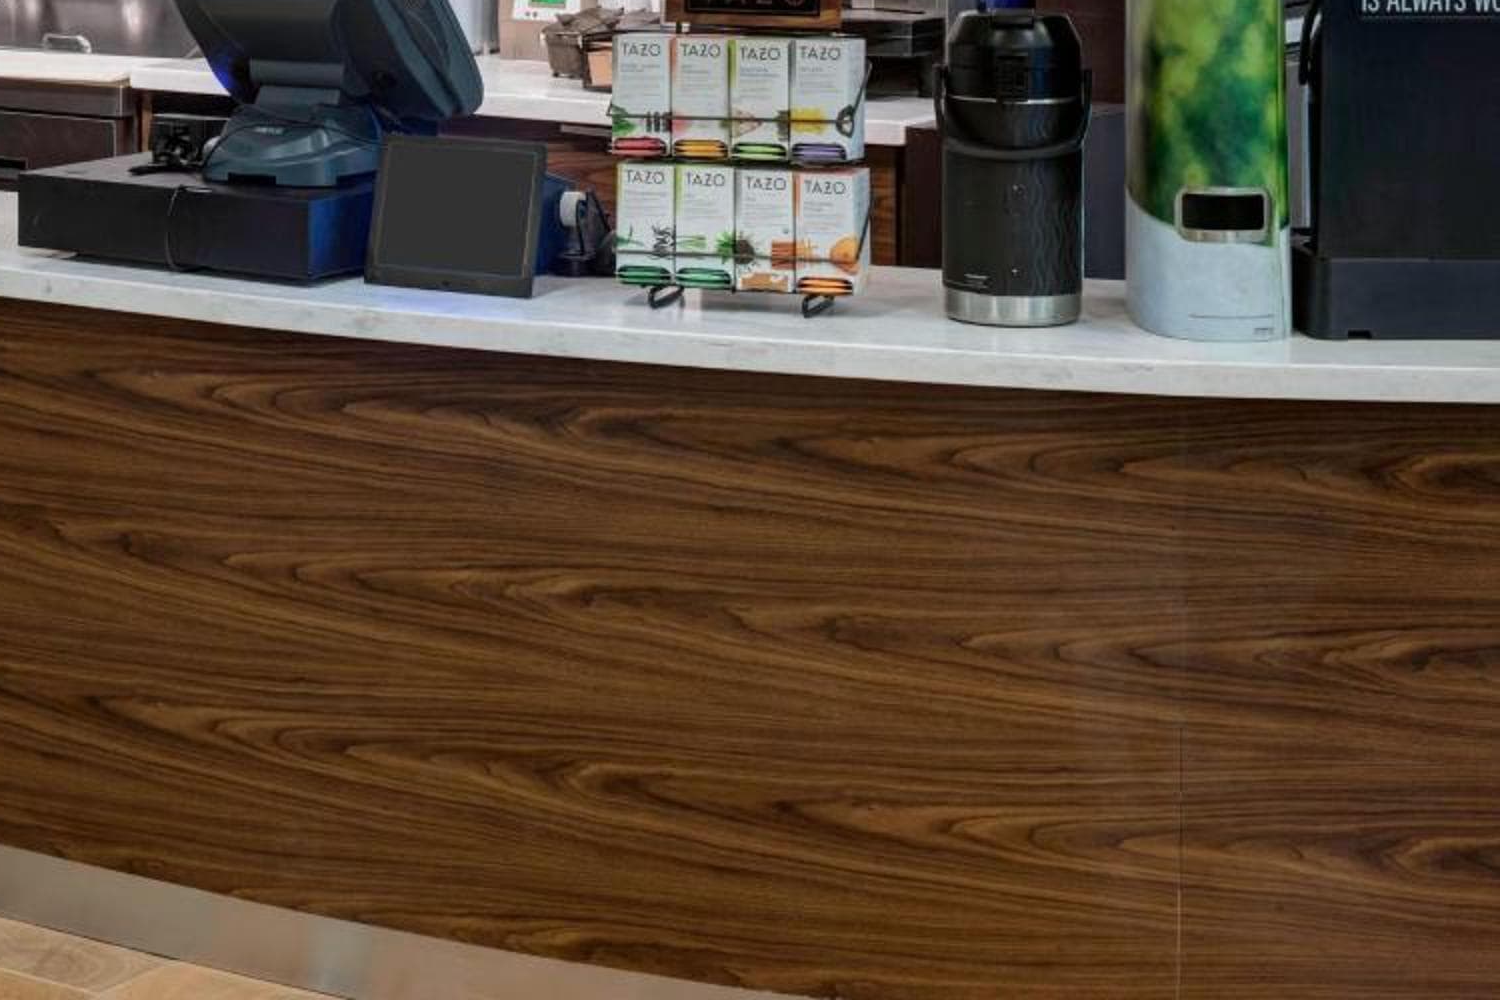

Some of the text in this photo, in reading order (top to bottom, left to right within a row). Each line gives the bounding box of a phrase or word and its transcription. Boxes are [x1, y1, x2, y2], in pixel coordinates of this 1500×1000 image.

[621, 42, 661, 58] TAZO
[680, 43, 722, 59] TAZO
[739, 46, 782, 62] TAZO
[800, 45, 842, 61] TAZO
[626, 169, 665, 185] TAZO
[686, 171, 726, 188] TAZO
[746, 176, 788, 192] TAZO
[803, 179, 846, 195] TAZO
